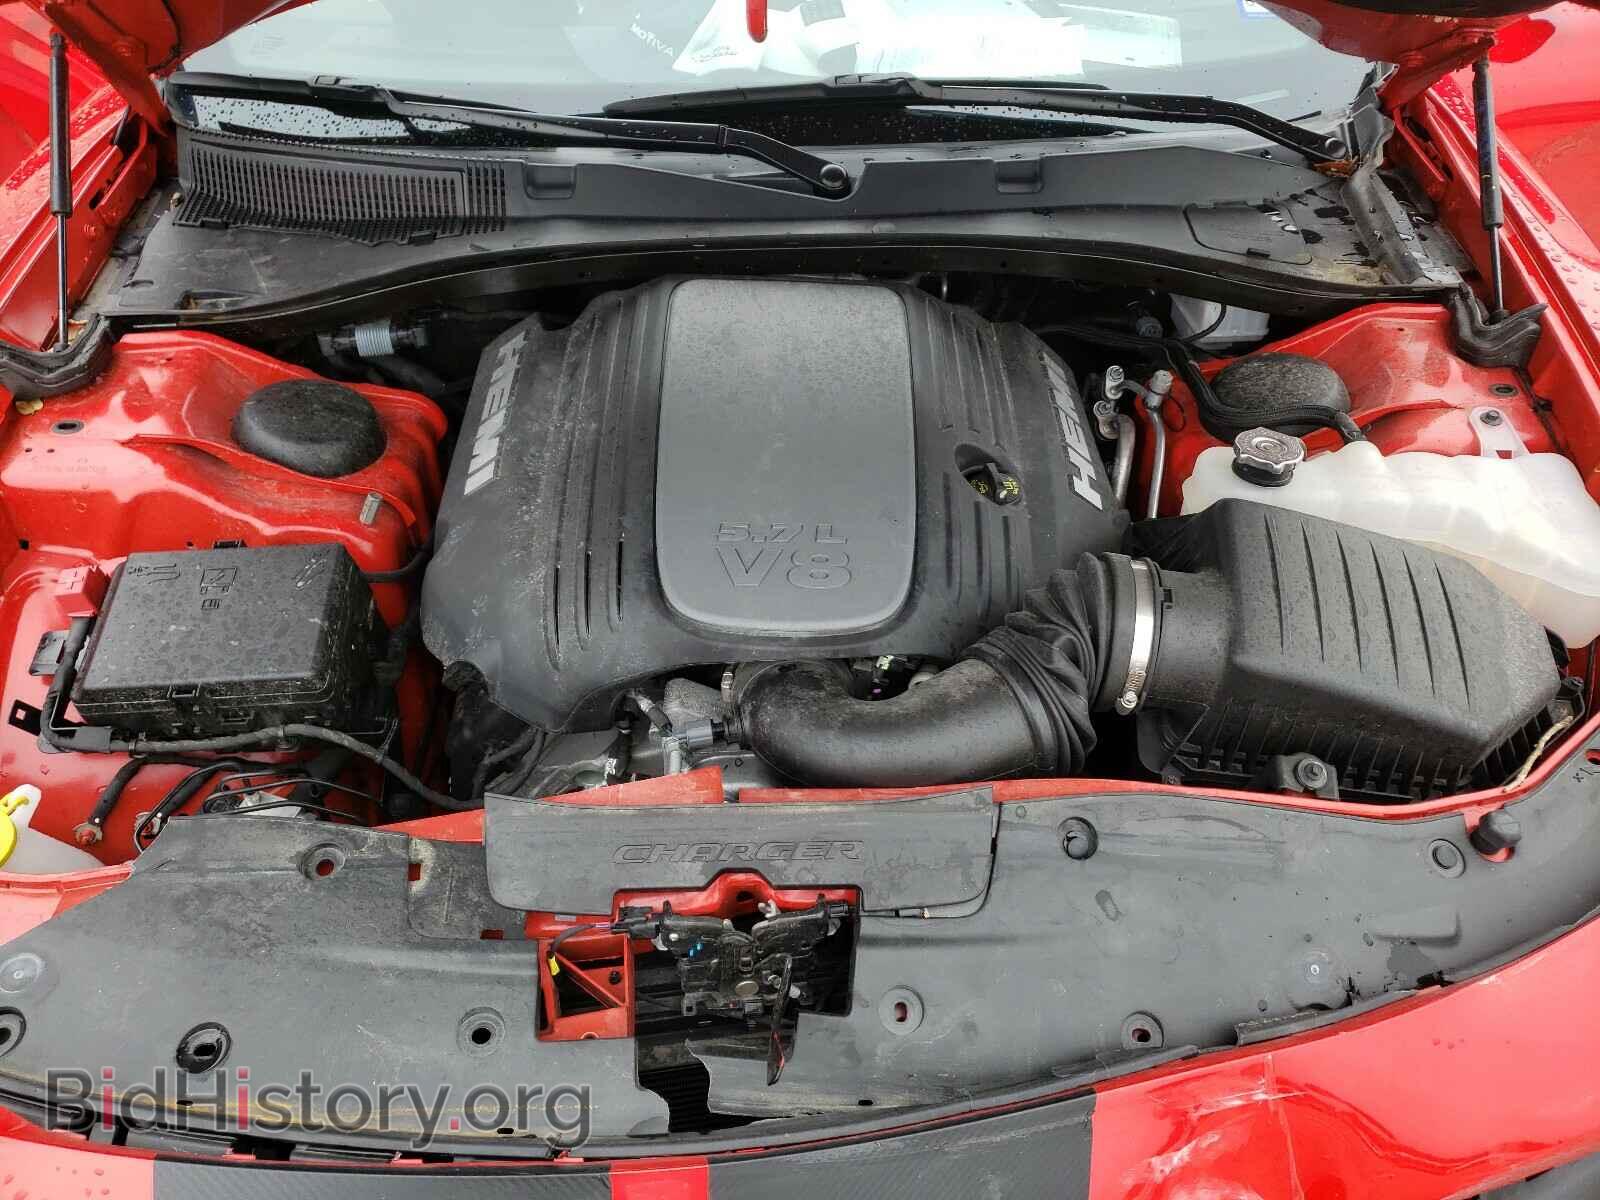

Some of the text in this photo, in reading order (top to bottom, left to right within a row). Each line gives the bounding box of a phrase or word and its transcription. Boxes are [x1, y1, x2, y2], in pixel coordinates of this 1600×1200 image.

[463, 331, 528, 496] HEMI
[1042, 351, 1104, 511] HEMI
[714, 547, 852, 590] V8
[611, 839, 865, 865] CHARGER
